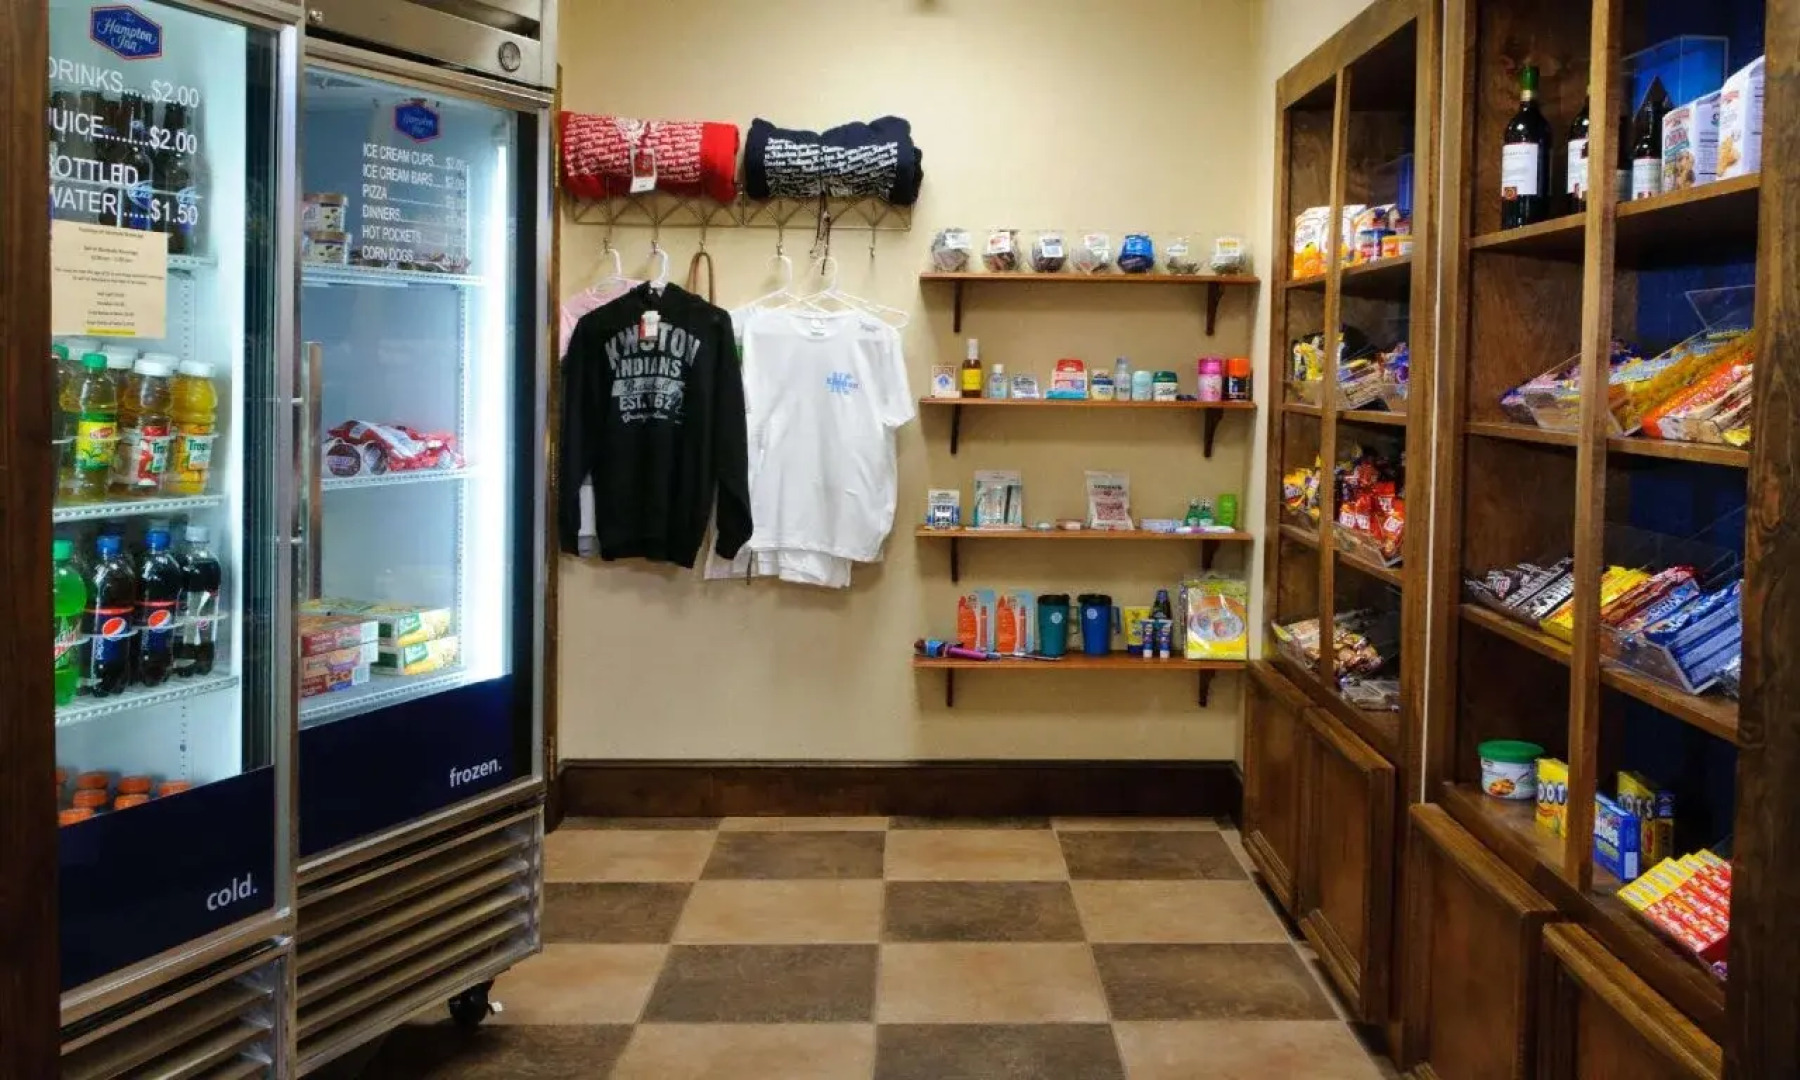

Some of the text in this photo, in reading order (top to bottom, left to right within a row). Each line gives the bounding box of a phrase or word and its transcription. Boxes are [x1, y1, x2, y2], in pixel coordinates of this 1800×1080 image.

[97, 19, 157, 45] Hampton
[111, 35, 143, 53] Inn
[152, 79, 199, 108] $2.00
[150, 125, 197, 154] $2.00
[380, 145, 409, 163] CREAM
[380, 166, 409, 183] CREAM
[362, 184, 388, 200] PIZZA
[151, 198, 198, 226] $1.50
[362, 204, 400, 221] DINNERS
[362, 225, 422, 244] HOT POCKETS
[362, 245, 387, 261] CORN
[390, 247, 413, 263] DOGS
[615, 355, 683, 378] INDIANS
[449, 758, 502, 788] frozen.
[207, 872, 258, 911] cold.
